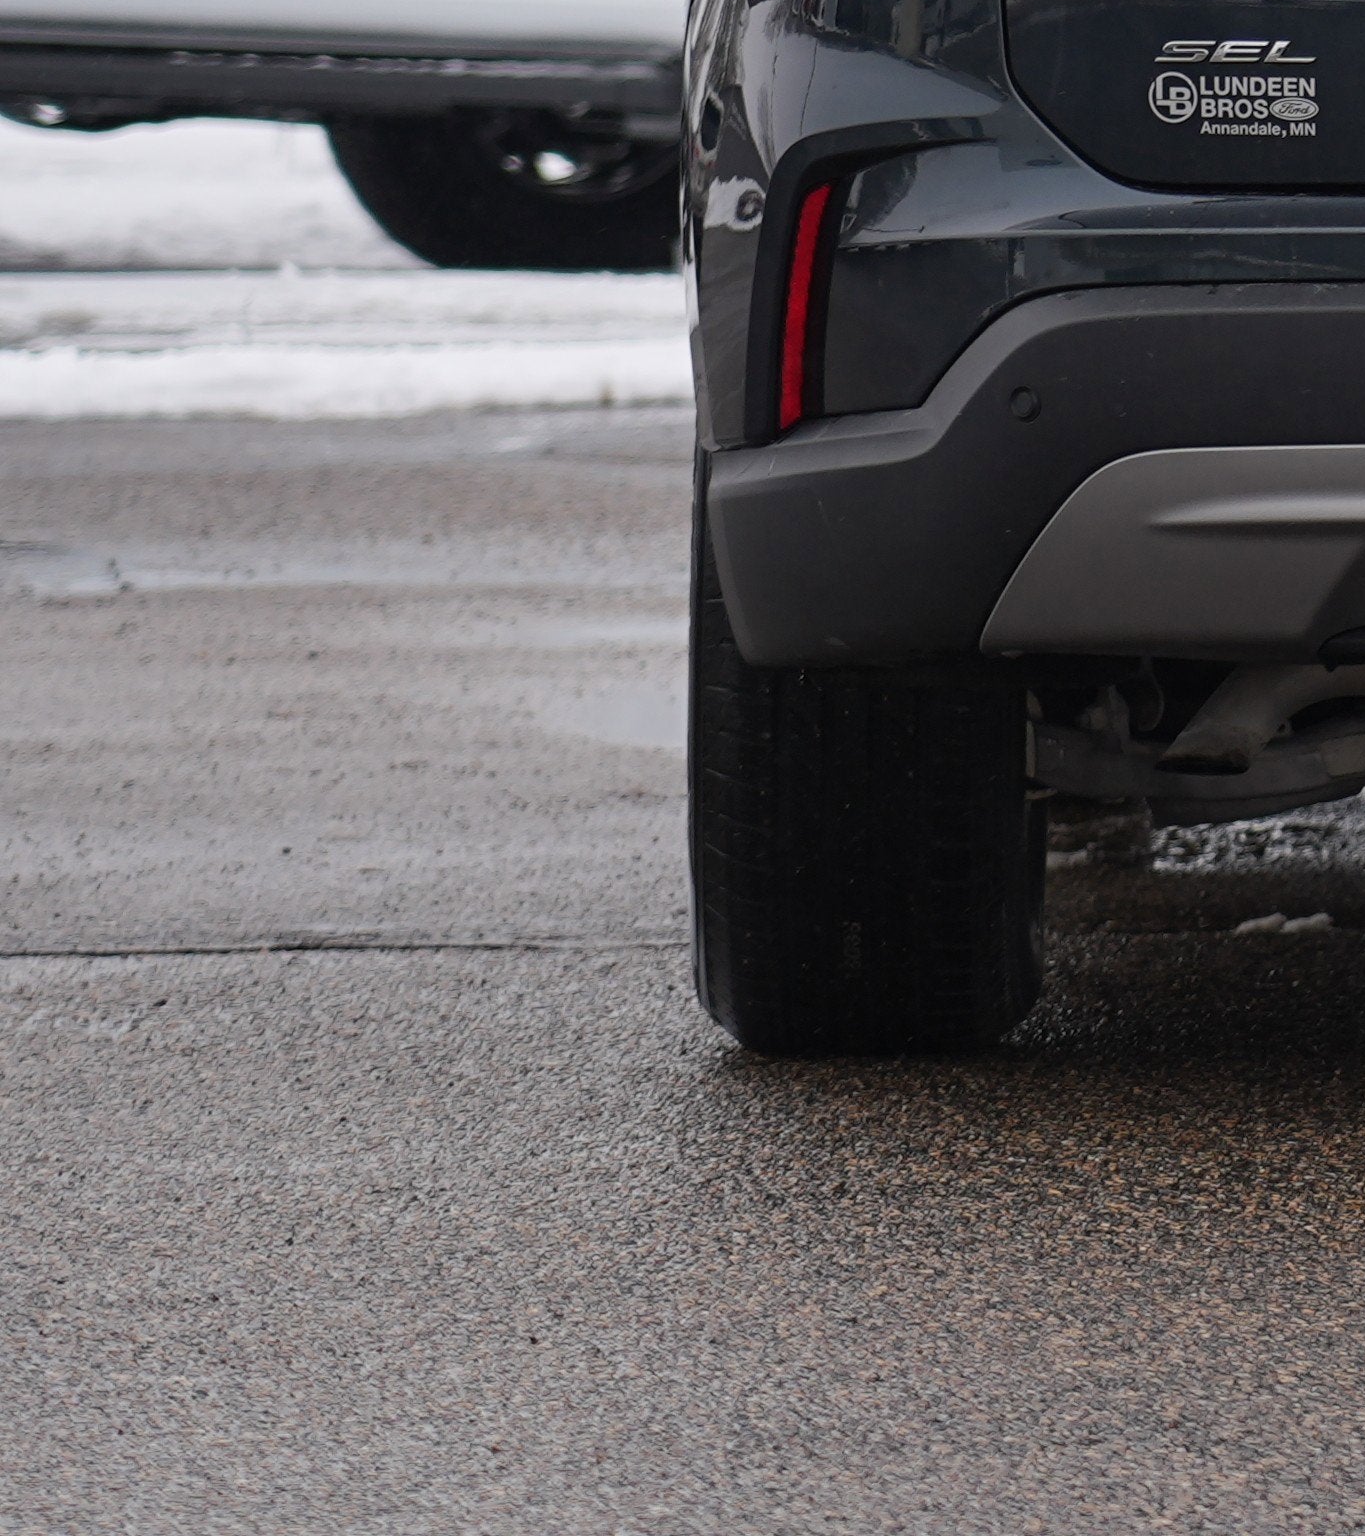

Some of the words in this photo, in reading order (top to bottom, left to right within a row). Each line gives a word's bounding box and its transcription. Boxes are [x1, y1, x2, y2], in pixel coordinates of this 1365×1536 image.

[1154, 40, 1317, 63] SEL
[1200, 75, 1316, 97] LUNDEEN
[1200, 98, 1268, 120] BROS
[1200, 121, 1287, 139] Annandale,
[1289, 122, 1317, 137] MN
